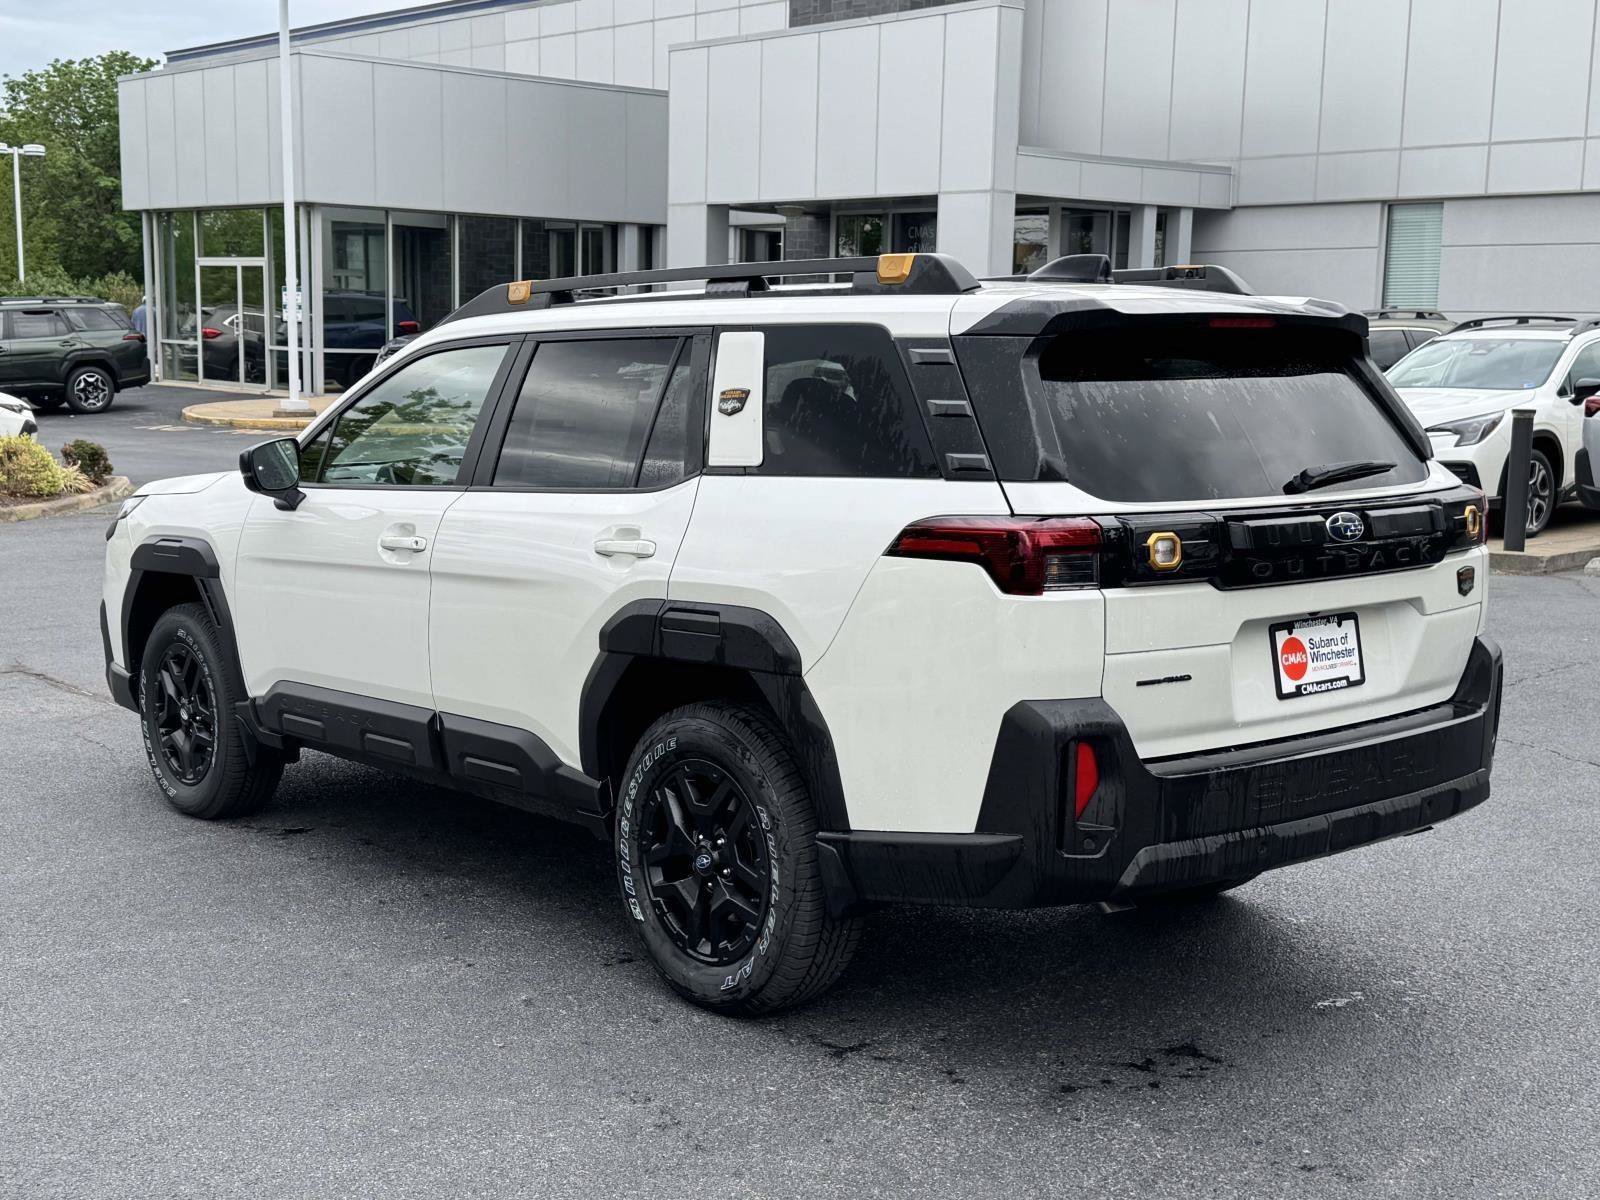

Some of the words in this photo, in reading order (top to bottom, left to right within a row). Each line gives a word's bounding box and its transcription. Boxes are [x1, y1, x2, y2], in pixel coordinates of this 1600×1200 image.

[1252, 544, 1432, 578] OUTBACK
[1329, 615, 1338, 625] VA
[1309, 636, 1338, 649] Subaru
[1340, 632, 1349, 645] of
[1281, 651, 1307, 666] CMA's
[1310, 647, 1355, 663] Winchester
[1301, 679, 1348, 695] CMAcars.com
[615, 736, 678, 922] BRIDGESTONE
[756, 805, 780, 956] DUELER
[720, 956, 755, 990] A/T
